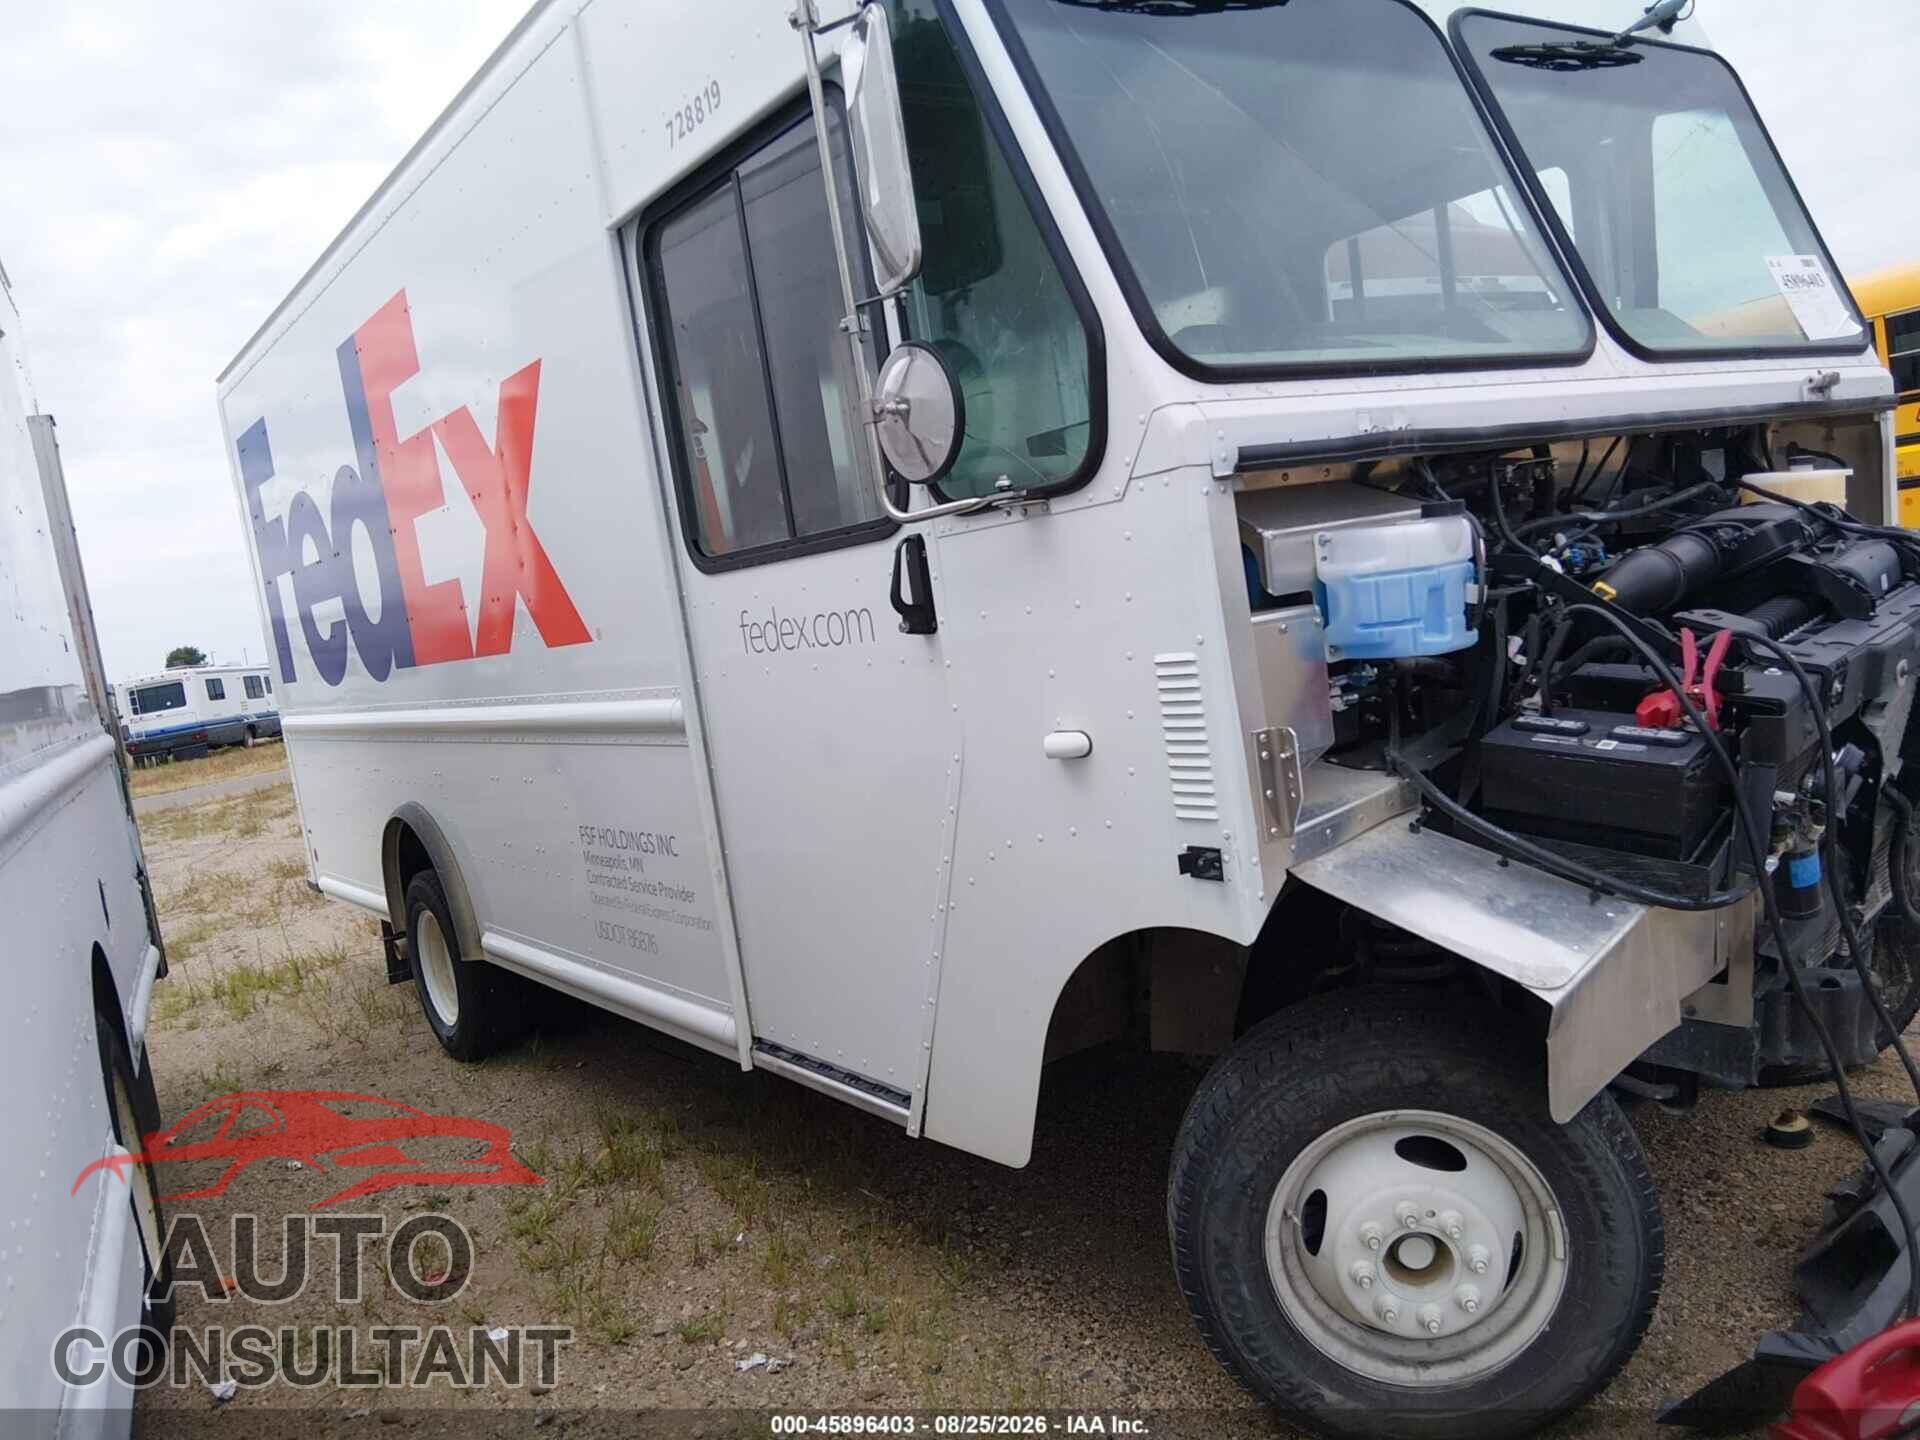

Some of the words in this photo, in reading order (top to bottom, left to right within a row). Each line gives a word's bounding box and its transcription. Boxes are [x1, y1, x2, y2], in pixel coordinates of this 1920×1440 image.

[665, 80, 720, 150] 728819
[236, 288, 593, 687] FedEx
[739, 605, 876, 654] fedex.com
[578, 825, 596, 845] FSF
[598, 828, 655, 854] HOLDINGS
[656, 834, 679, 857] INC
[629, 856, 645, 873] MN
[586, 869, 628, 890] Contracted
[628, 876, 657, 897] Service
[658, 880, 696, 904] Provider
[594, 919, 626, 946] USDOT
